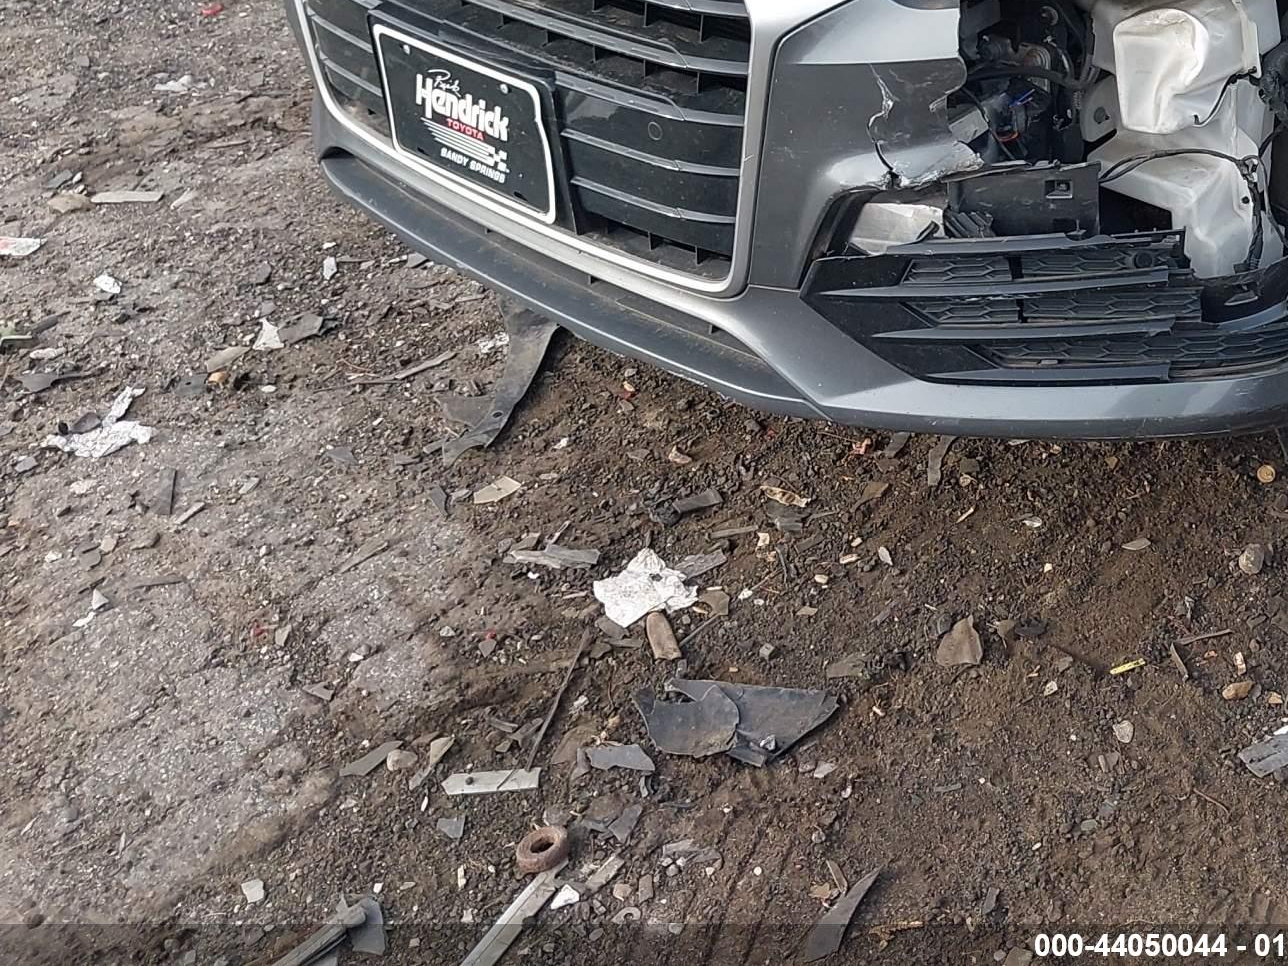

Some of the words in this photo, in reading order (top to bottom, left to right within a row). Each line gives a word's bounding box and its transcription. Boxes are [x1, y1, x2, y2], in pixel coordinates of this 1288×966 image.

[415, 73, 510, 142] Hendrick
[446, 118, 485, 141] TOYOTA
[440, 147, 469, 169] SANDY
[469, 159, 506, 184] SPRINGS
